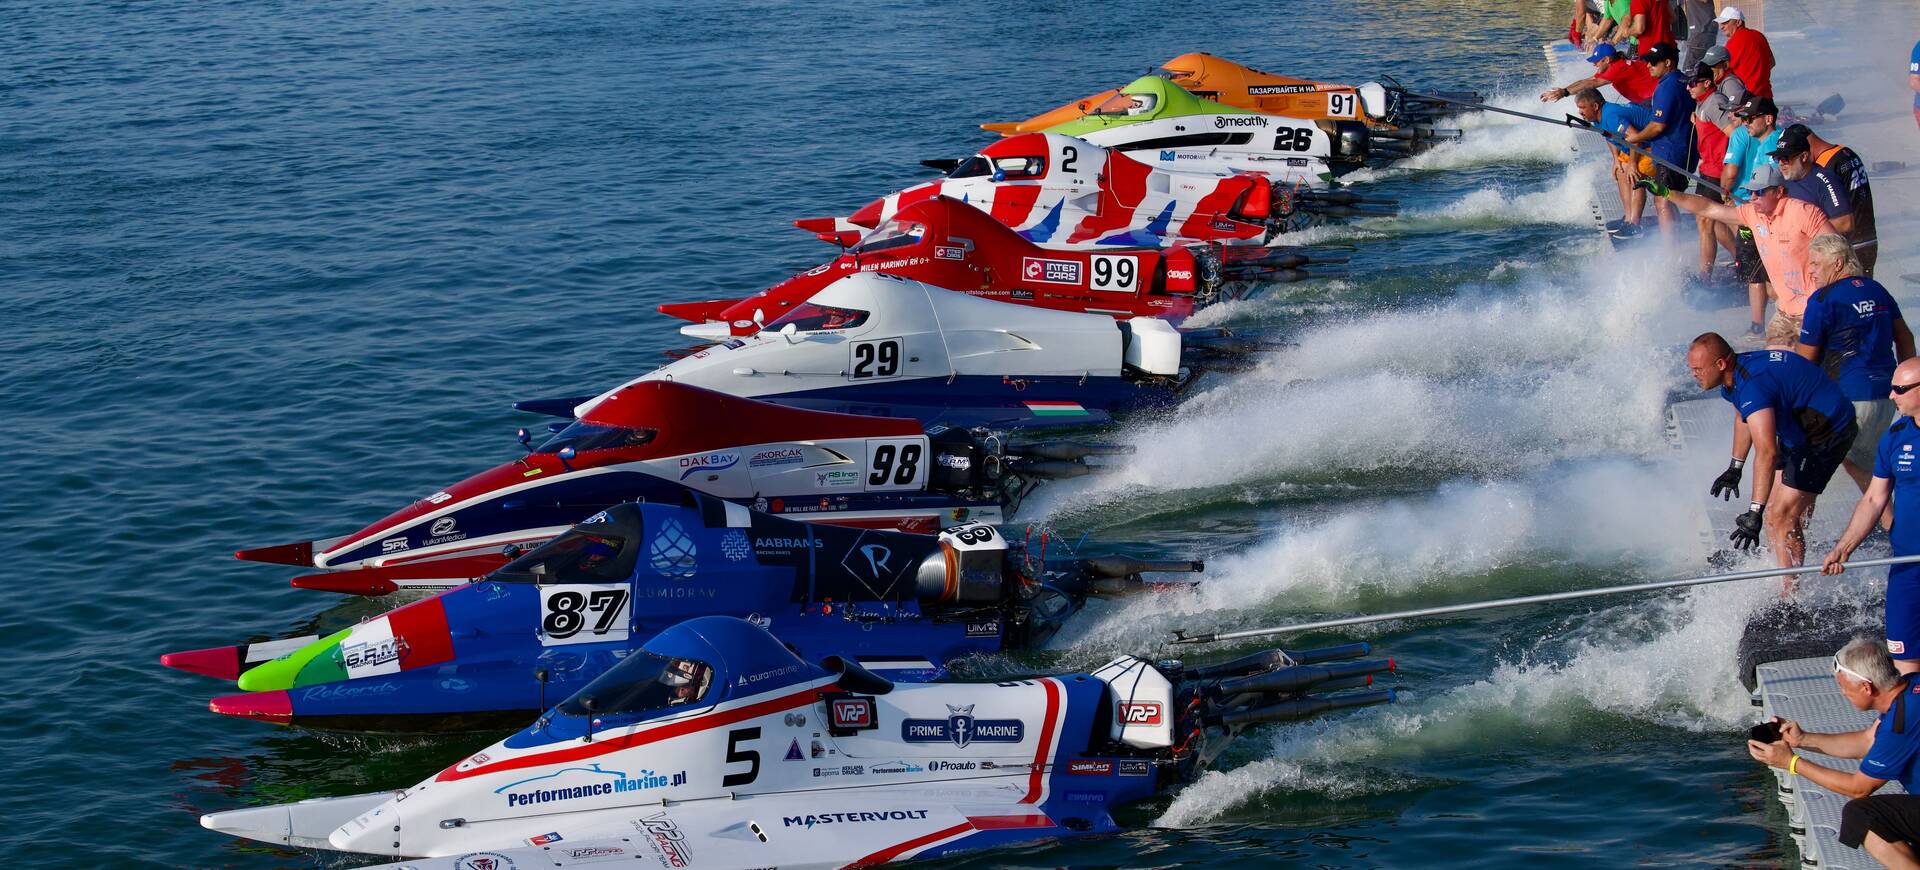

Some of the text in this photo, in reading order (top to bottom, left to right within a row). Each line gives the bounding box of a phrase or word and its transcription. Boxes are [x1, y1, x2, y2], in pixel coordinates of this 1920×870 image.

[1250, 86, 1298, 95] ПАЗАРУВАЙТЕ
[1331, 94, 1354, 115] 91
[1273, 126, 1313, 152] 26
[1062, 145, 1078, 173] 2
[860, 262, 879, 273] MILEN
[880, 259, 909, 270] MARINOV
[1046, 262, 1076, 273] INTER
[1094, 257, 1135, 288] 99
[1046, 271, 1076, 281] CARS
[1852, 300, 1876, 314] VRP
[854, 341, 899, 379] 29
[869, 444, 922, 486] 98
[382, 536, 410, 552] SPK
[755, 537, 824, 549] AABRAMS
[543, 589, 630, 639] 87
[967, 623, 987, 632] UIM
[750, 664, 798, 682] auramarine
[837, 704, 866, 722] VRP
[1121, 705, 1158, 722] VRP
[909, 725, 1018, 736] PRIME MARINE
[722, 726, 761, 788] 5
[940, 760, 976, 771] Proauto
[1071, 763, 1110, 772] SIMRAD
[508, 770, 687, 807] Performance Marine .pl
[783, 810, 928, 828] MASTERVOLT
